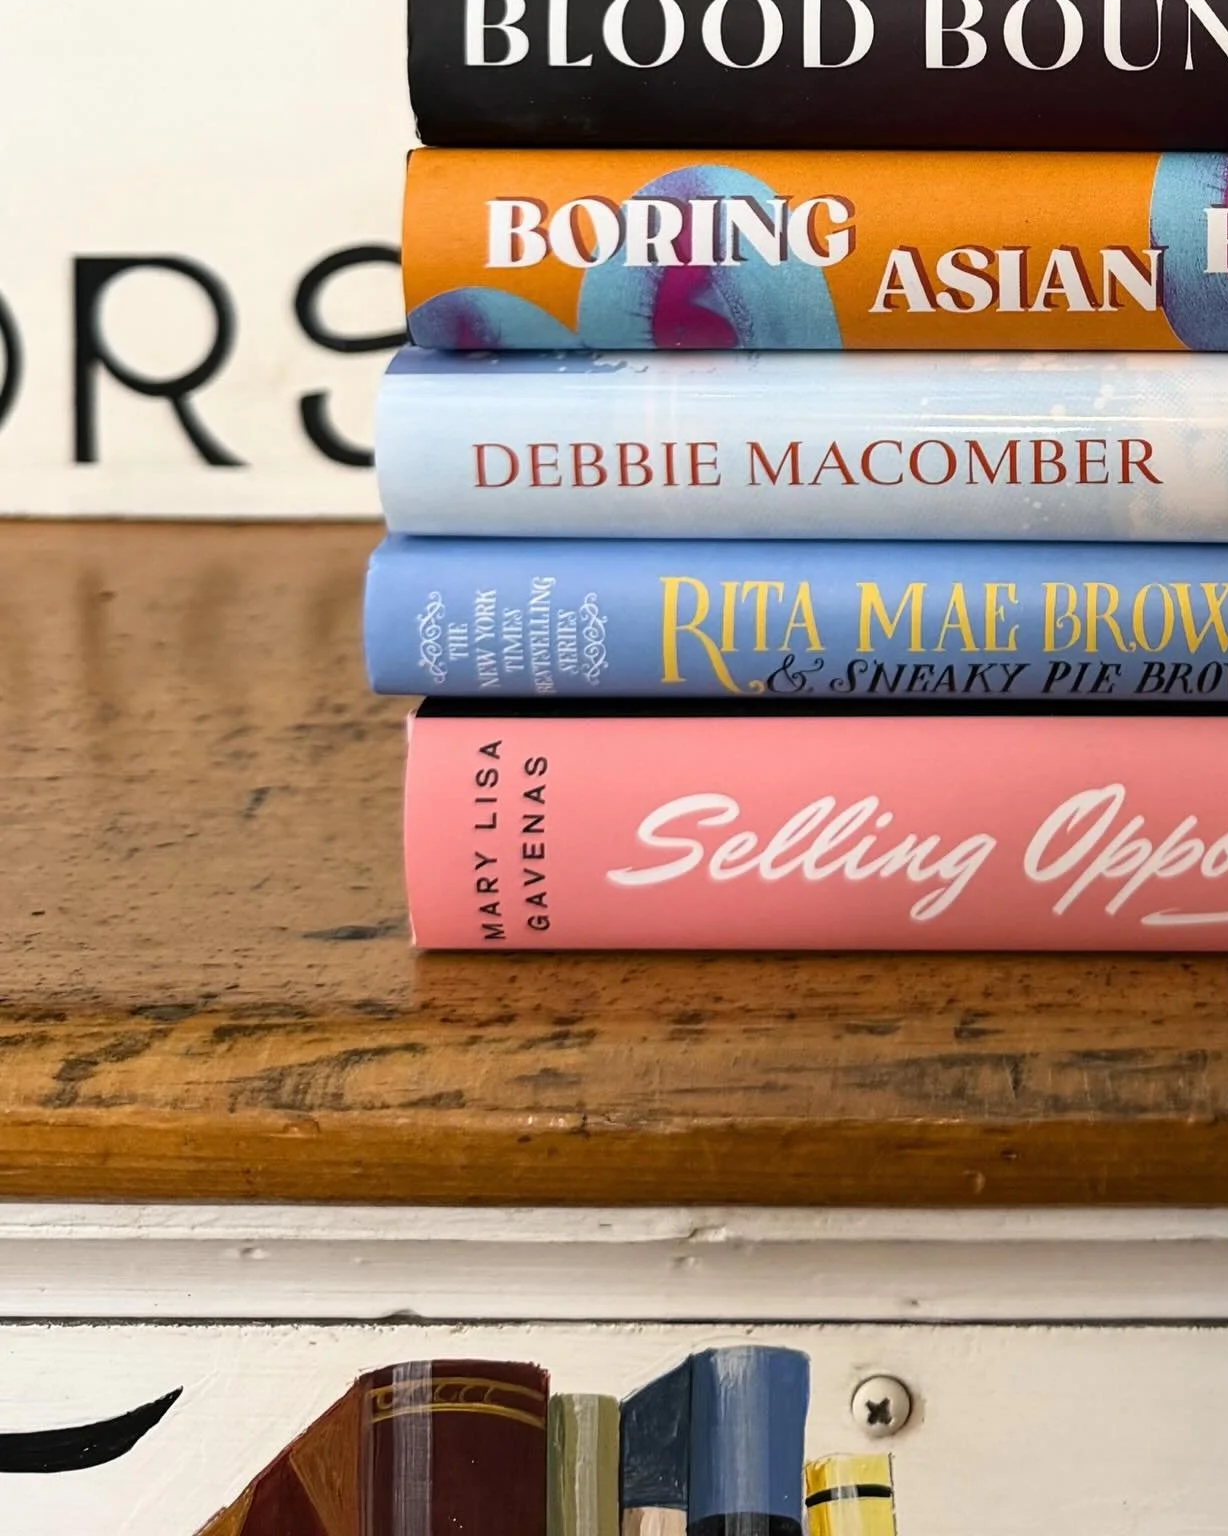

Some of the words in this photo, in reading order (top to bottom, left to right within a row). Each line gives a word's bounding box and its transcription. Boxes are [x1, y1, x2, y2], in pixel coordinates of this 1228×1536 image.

[484, 193, 857, 269] BORING
[866, 243, 1165, 315] ASIAN
[472, 440, 723, 490] DEBBIE
[745, 438, 1165, 487] MACOMBER
[447, 623, 469, 661] THE
[473, 589, 497, 644] YORK
[501, 607, 525, 673] TIMES
[528, 576, 557, 695] BESTSELLING
[556, 608, 579, 675] SERIES
[659, 575, 822, 694] RITA
[856, 582, 1020, 653] MAE
[475, 647, 501, 688] NEW
[767, 654, 827, 696] &
[828, 658, 1032, 695] SNEAKY
[1043, 661, 1123, 694] PIE
[475, 739, 503, 834] LISA
[525, 755, 550, 932] GAVENAS
[607, 793, 998, 922] Selling
[475, 852, 506, 942] MARY
